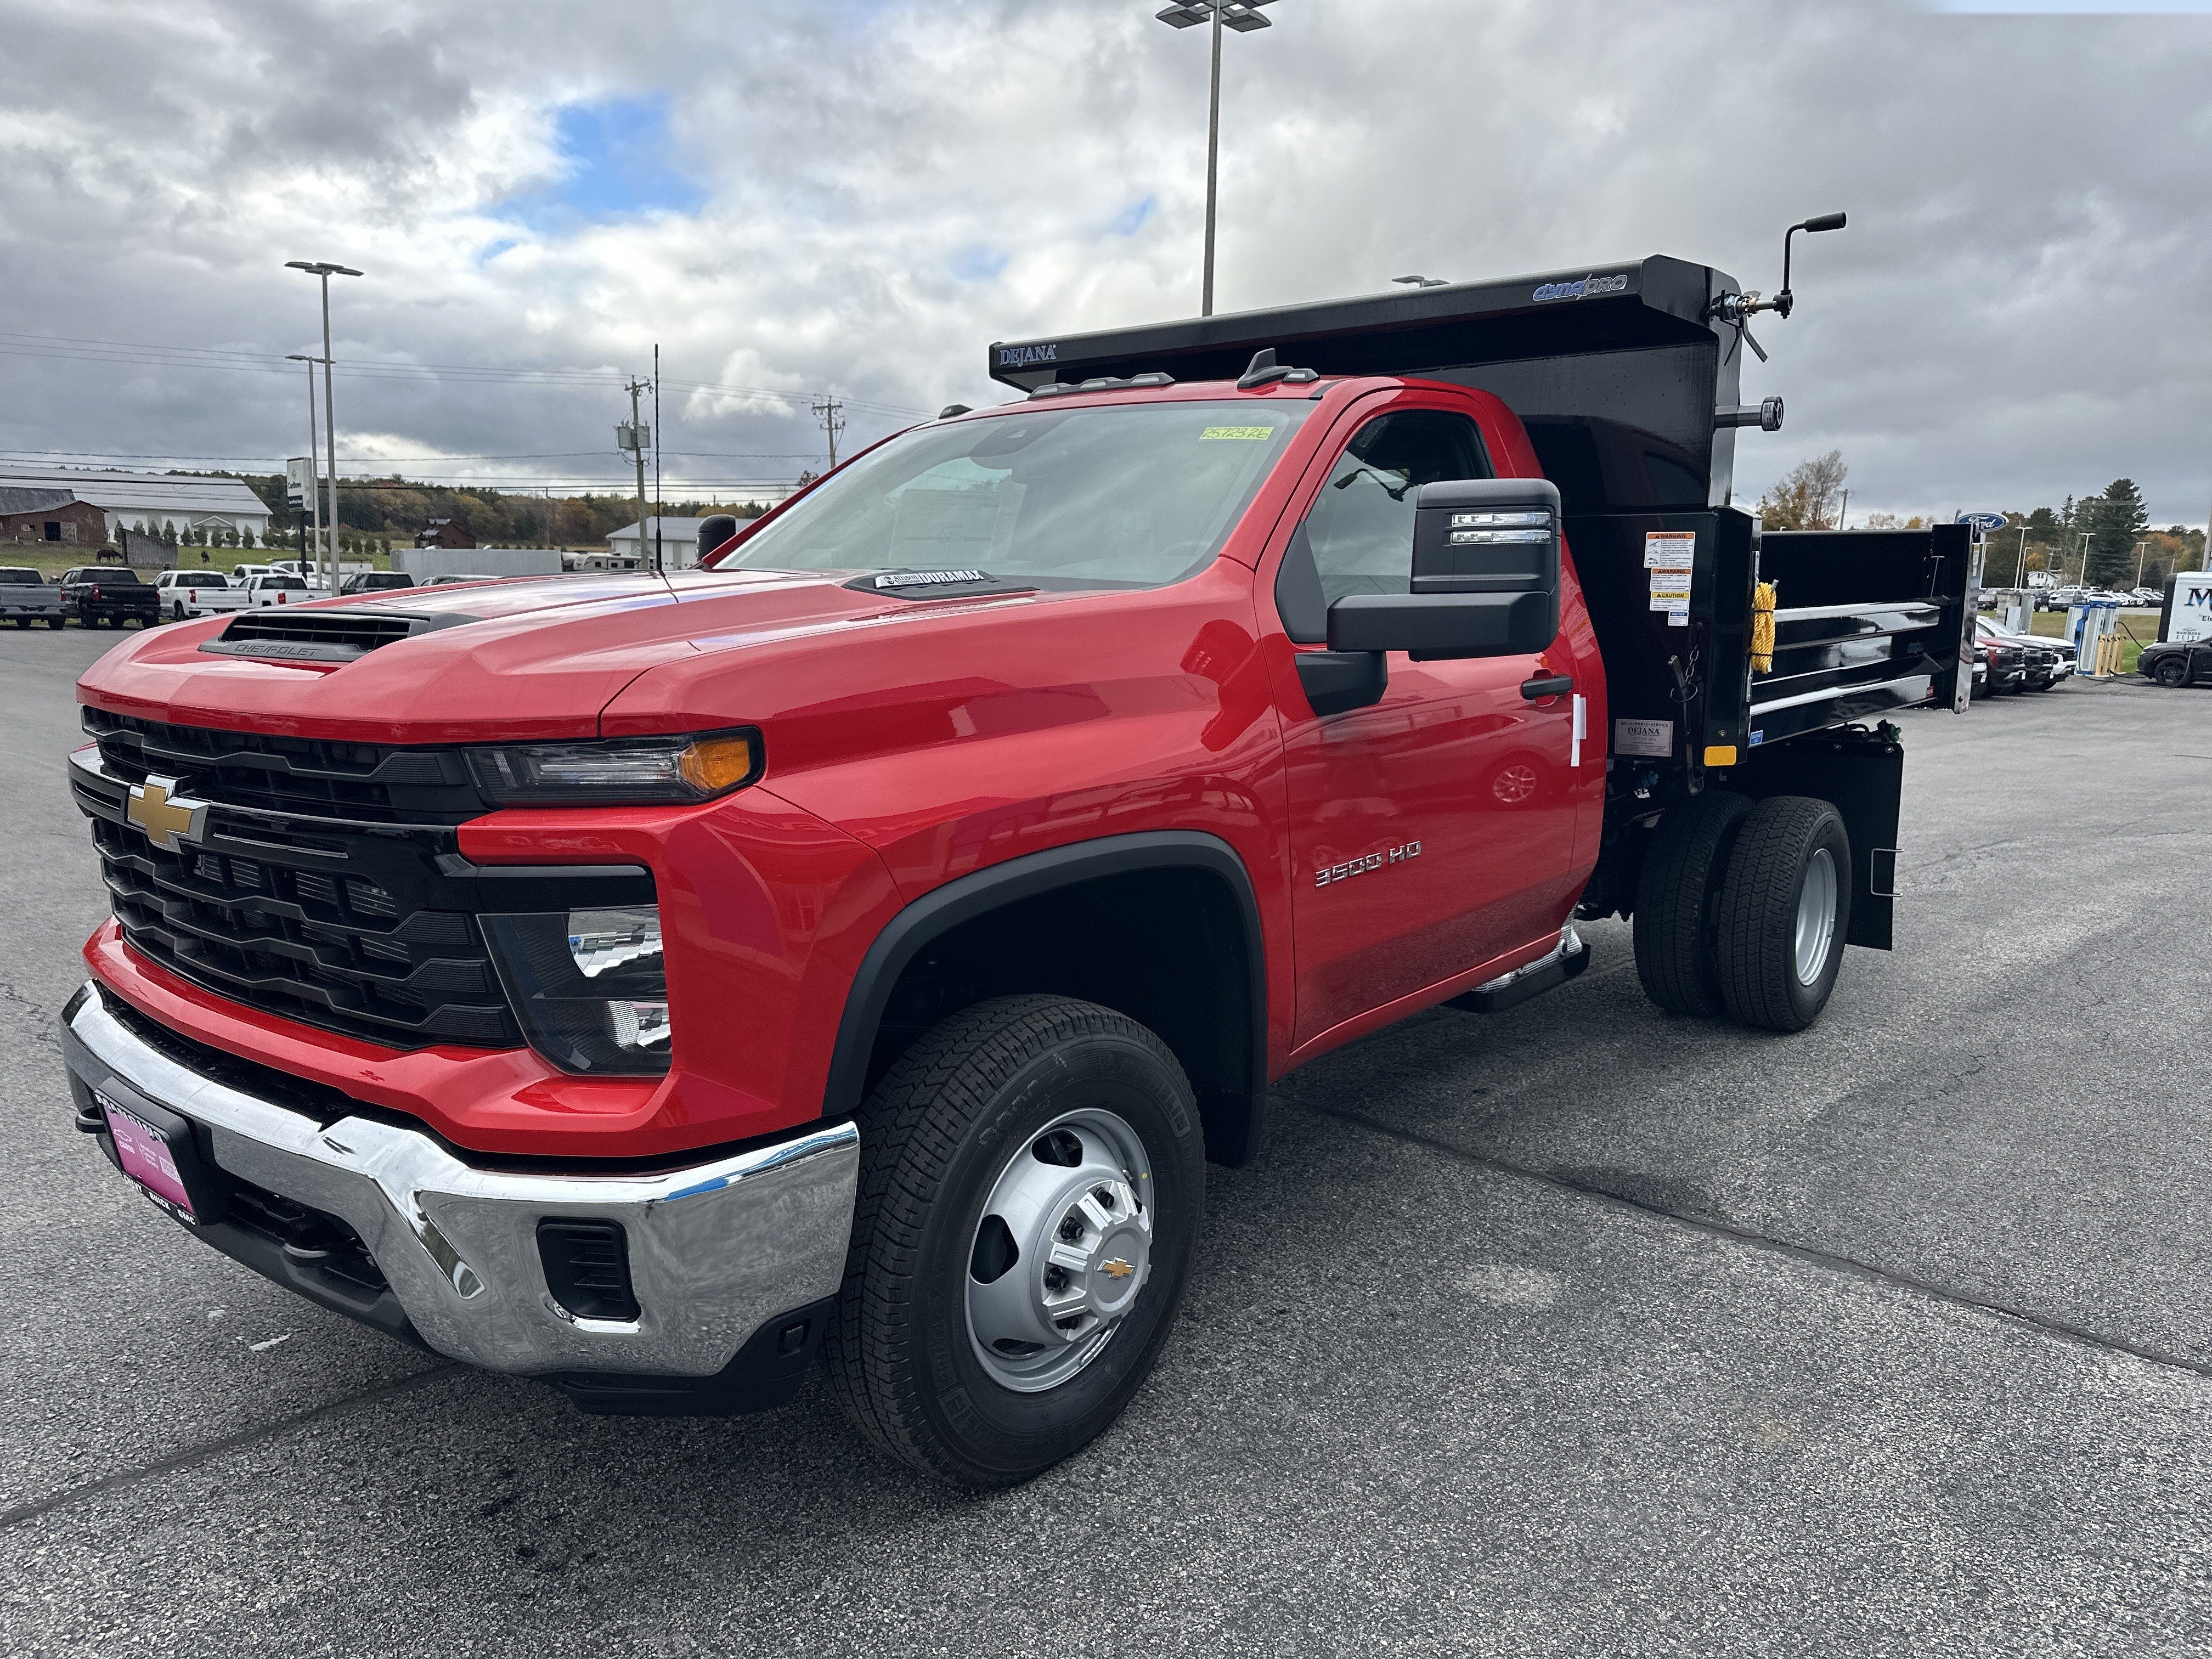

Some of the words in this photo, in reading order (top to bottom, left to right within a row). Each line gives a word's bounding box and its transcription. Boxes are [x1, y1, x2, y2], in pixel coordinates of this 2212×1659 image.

[1000, 344, 1056, 367] DEJANA
[918, 569, 984, 584] DURAMAX
[234, 644, 322, 657] CHEVROLET
[1628, 727, 1660, 735] DEJANA
[1315, 853, 1381, 888] 3500
[1389, 840, 1421, 864] HD
[149, 1191, 171, 1211] BUICK
[177, 1209, 196, 1226] GMC
